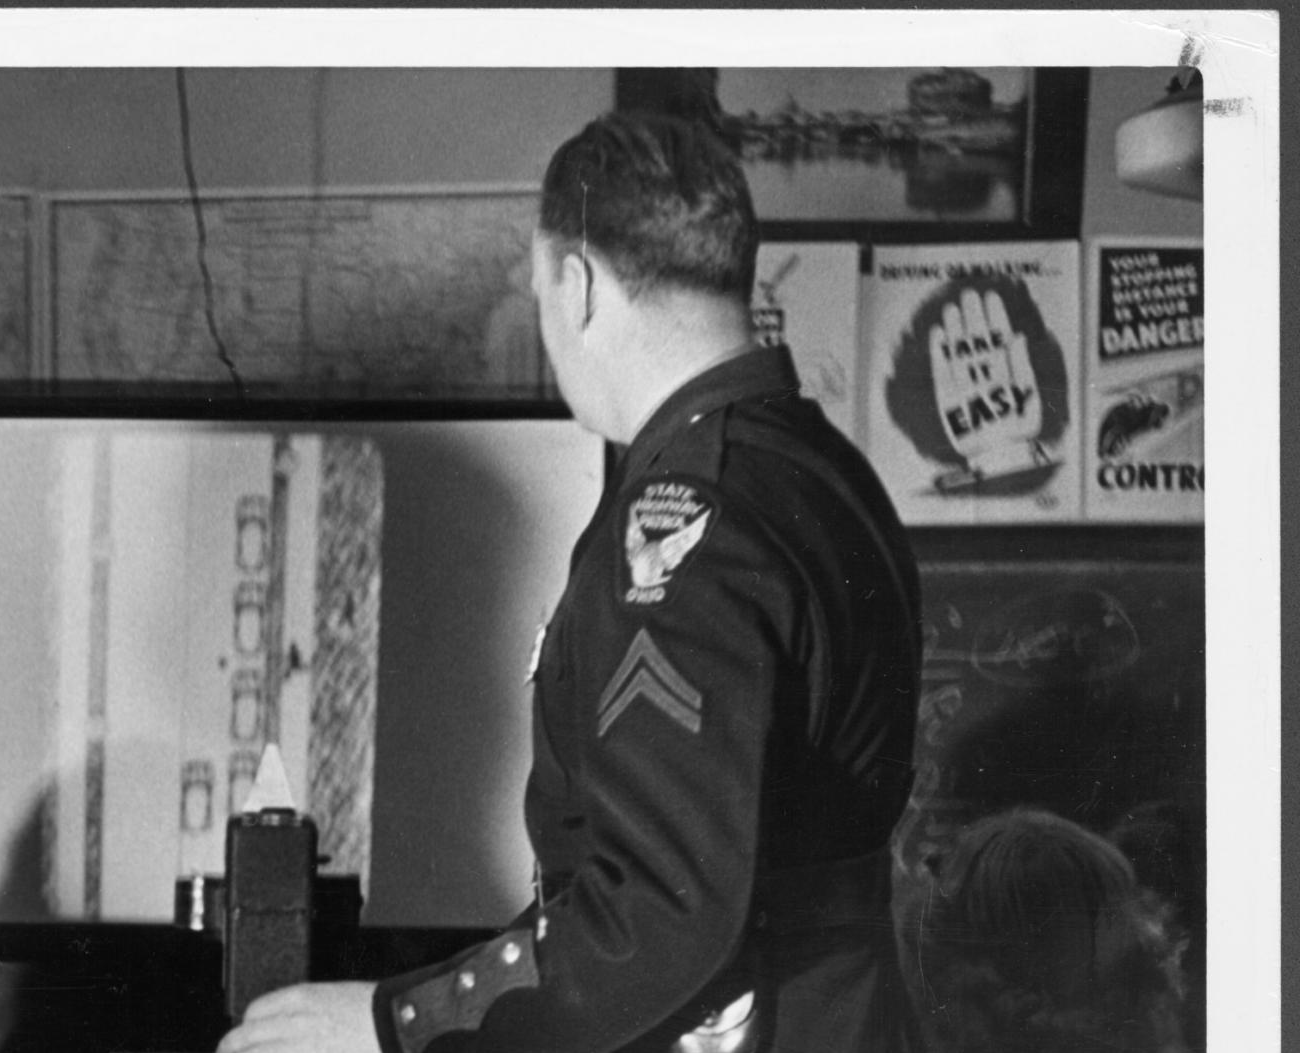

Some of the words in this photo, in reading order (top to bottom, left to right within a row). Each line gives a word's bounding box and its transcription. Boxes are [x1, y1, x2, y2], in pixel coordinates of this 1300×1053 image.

[1108, 251, 1160, 272] YOUR
[1110, 262, 1197, 286] STOPPING
[1112, 280, 1198, 305] DISTANCE
[1115, 305, 1133, 323] IS
[1139, 299, 1189, 319] YOUR
[940, 329, 1003, 361] TAKE
[967, 361, 991, 383] IT
[945, 384, 1033, 437] EASY
[644, 482, 698, 500] STATE
[625, 585, 666, 605] OHIO
